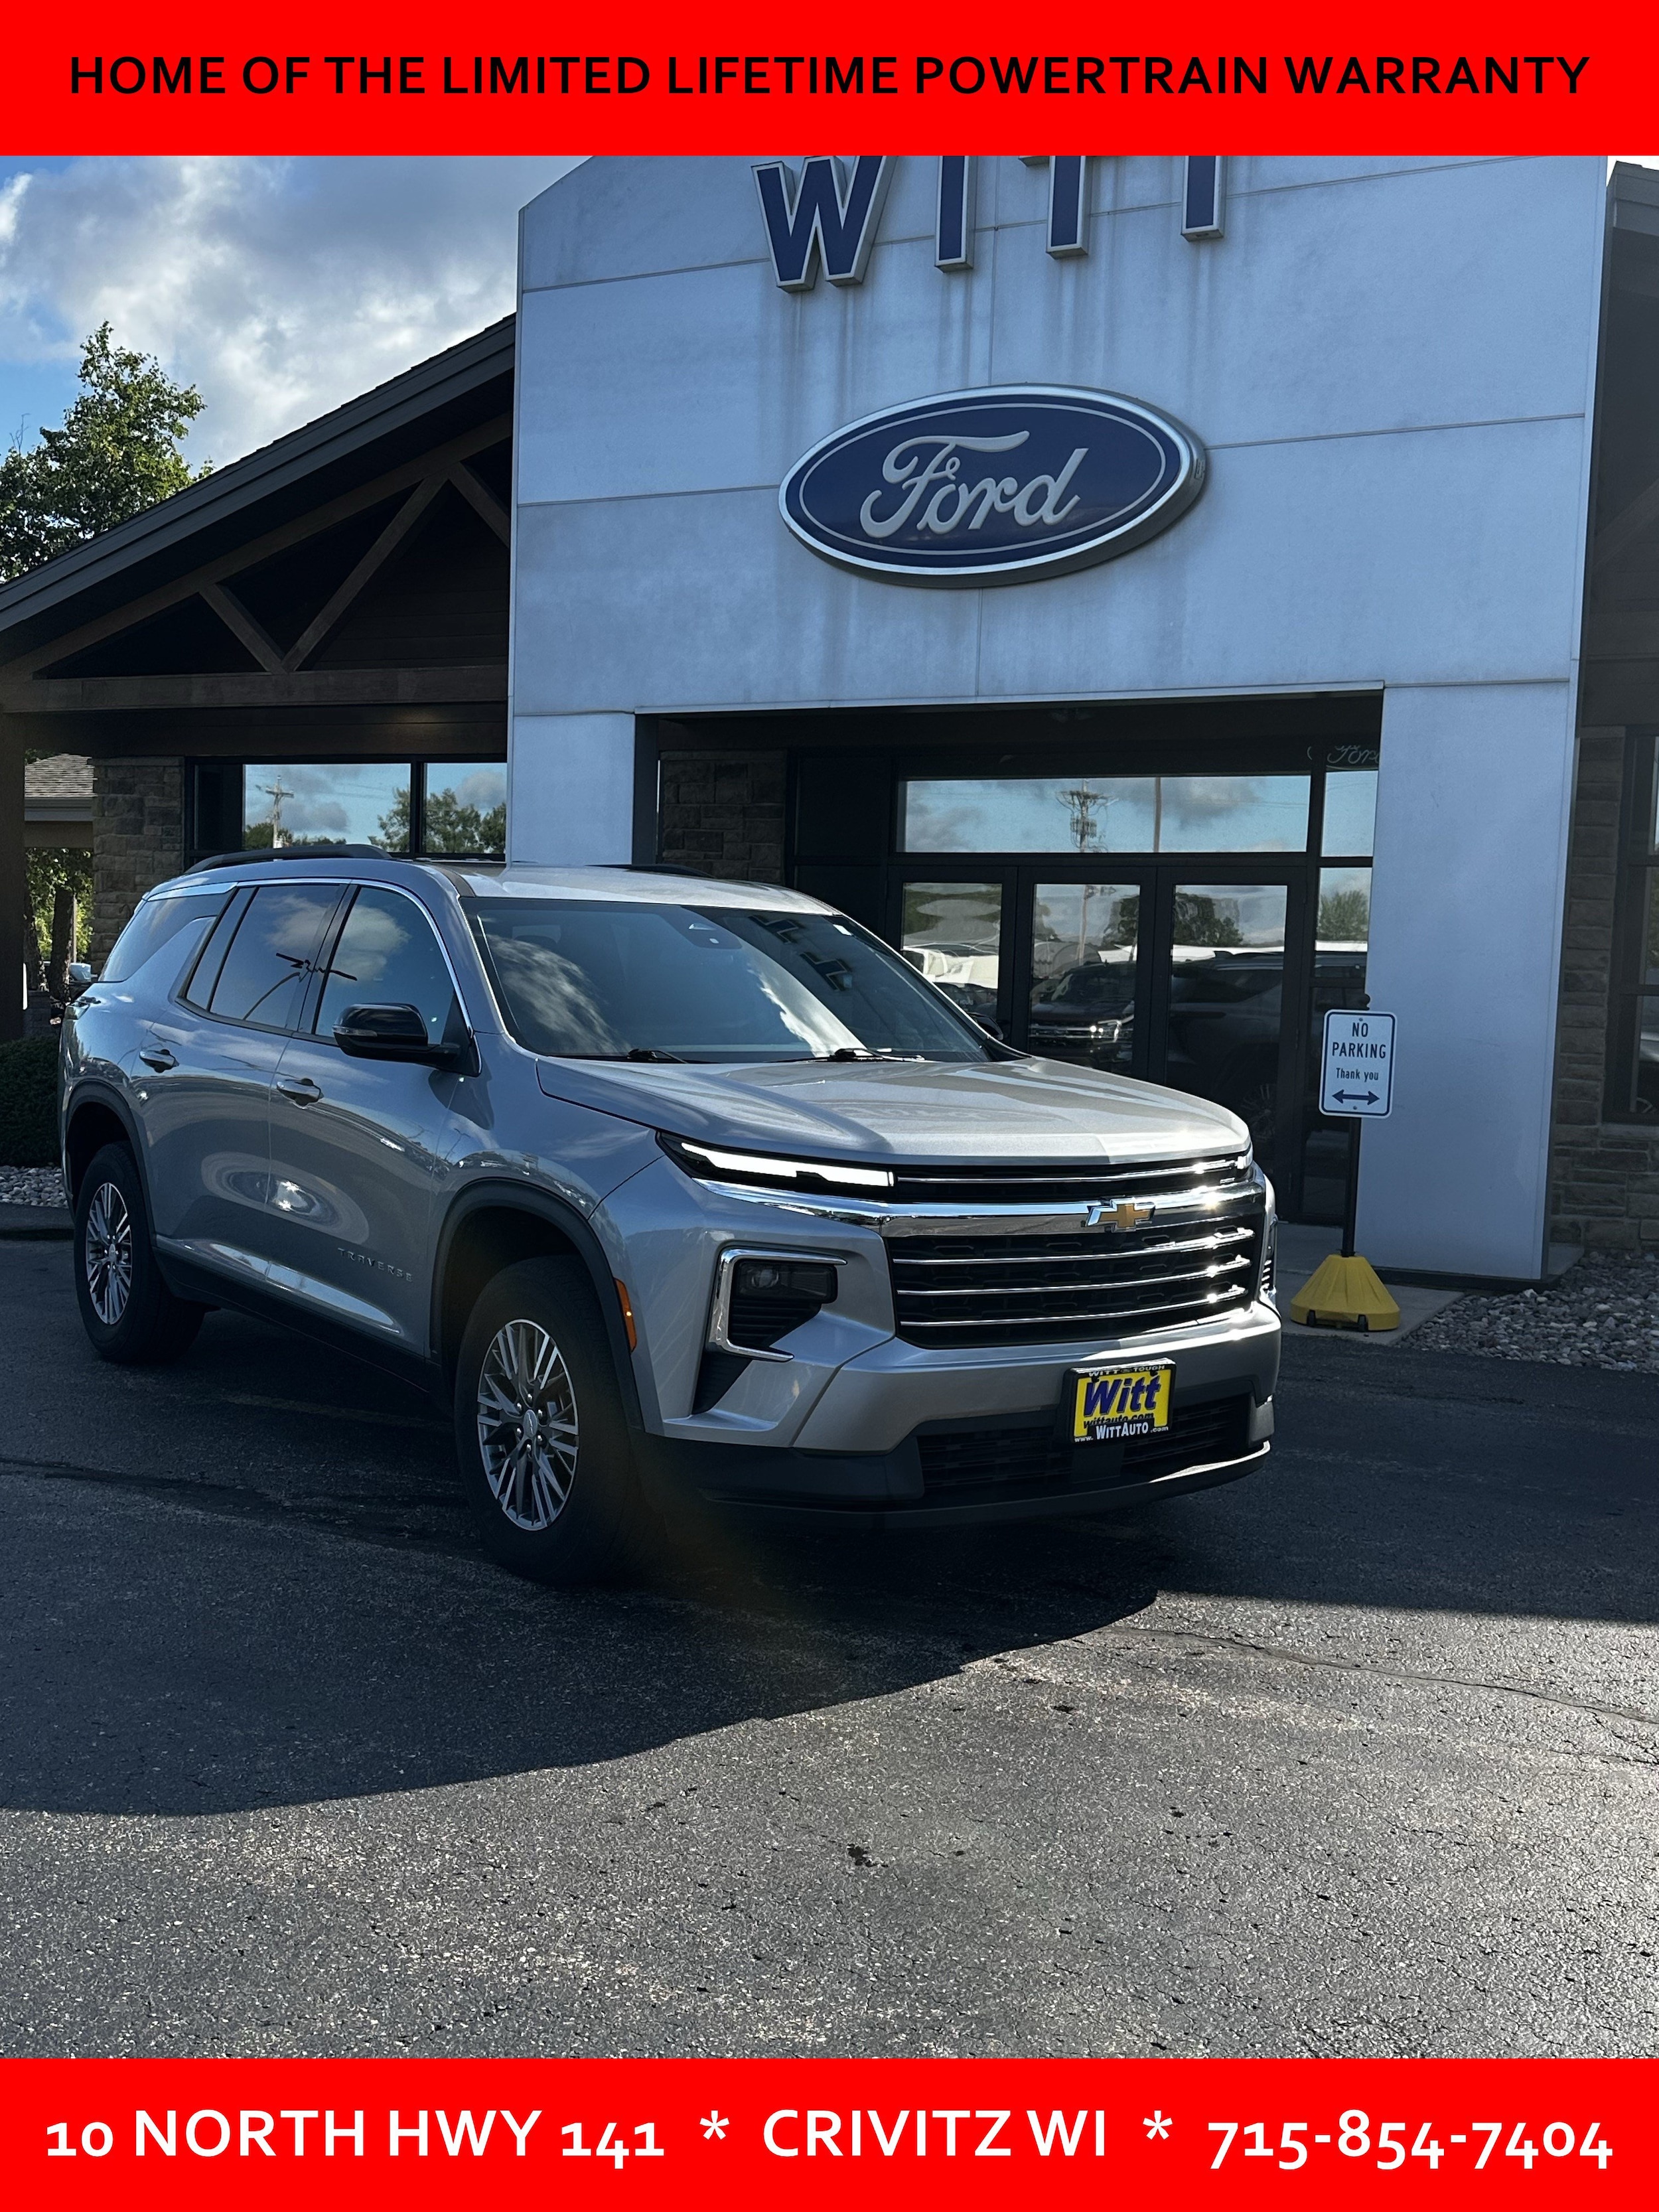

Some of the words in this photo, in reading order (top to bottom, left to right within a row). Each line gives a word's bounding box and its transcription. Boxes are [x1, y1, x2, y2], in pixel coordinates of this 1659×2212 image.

[860, 430, 1089, 538] Ford
[1352, 1022, 1368, 1037] NO
[1332, 1041, 1386, 1059] PARKING
[1336, 1067, 1360, 1080] Thank
[1364, 1071, 1379, 1082] you
[337, 1247, 413, 1282] TRAVERSE
[1084, 1374, 1161, 1417] Witt
[1083, 1413, 1154, 1429] wittautocom
